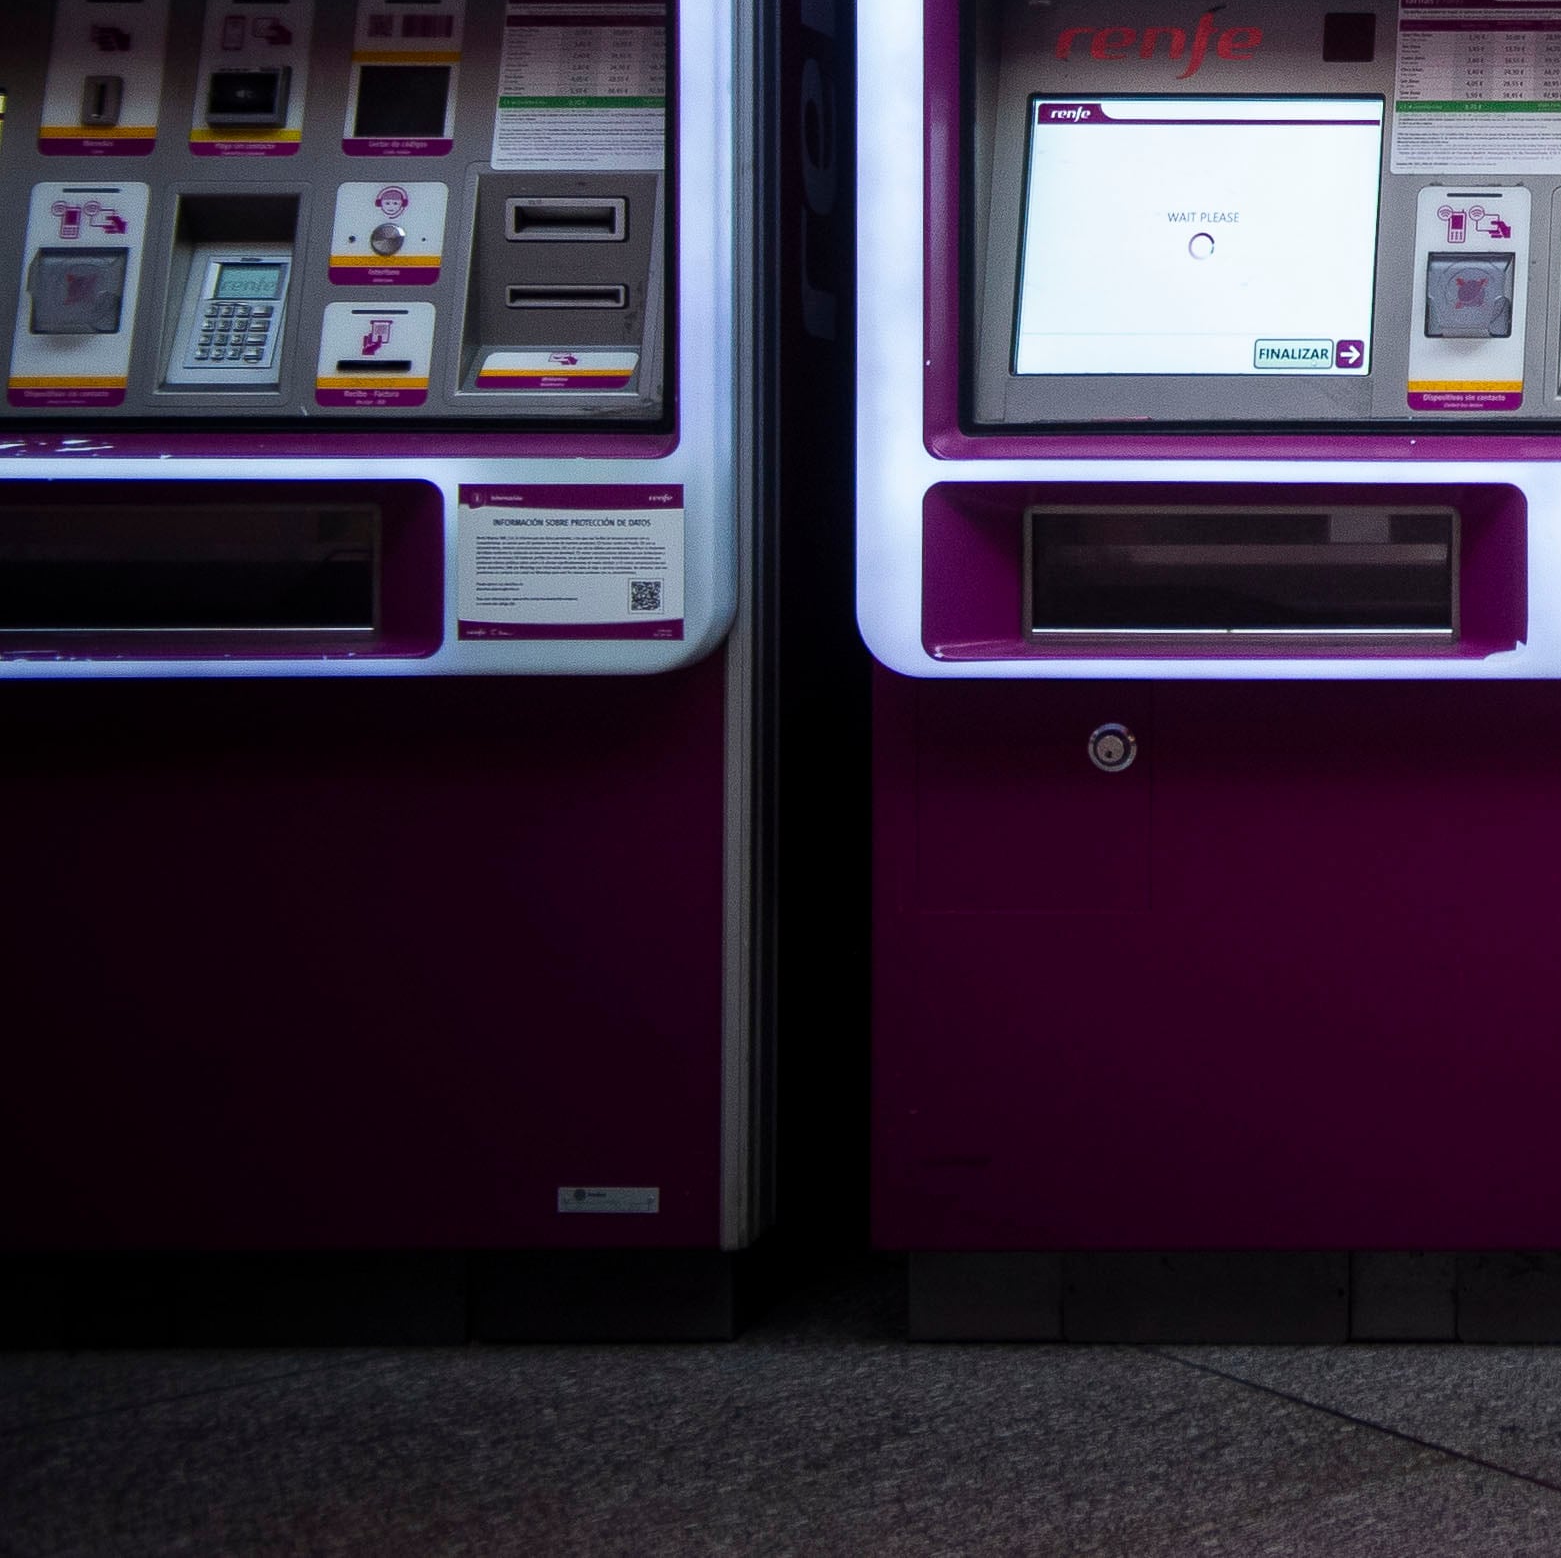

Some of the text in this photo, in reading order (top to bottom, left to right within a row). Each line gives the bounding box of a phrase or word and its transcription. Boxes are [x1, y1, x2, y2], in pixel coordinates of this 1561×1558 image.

[1055, 8, 1263, 80] renfe
[1051, 106, 1091, 123] renfe
[1167, 212, 1240, 223] WAIT PLEASE
[1259, 348, 1329, 360] FINALIZAR
[1423, 394, 1463, 402] Dispositivos
[1477, 394, 1505, 402] contacto
[493, 517, 543, 526] INFORMACIÓN
[571, 517, 615, 526] PROTECCIÓN
